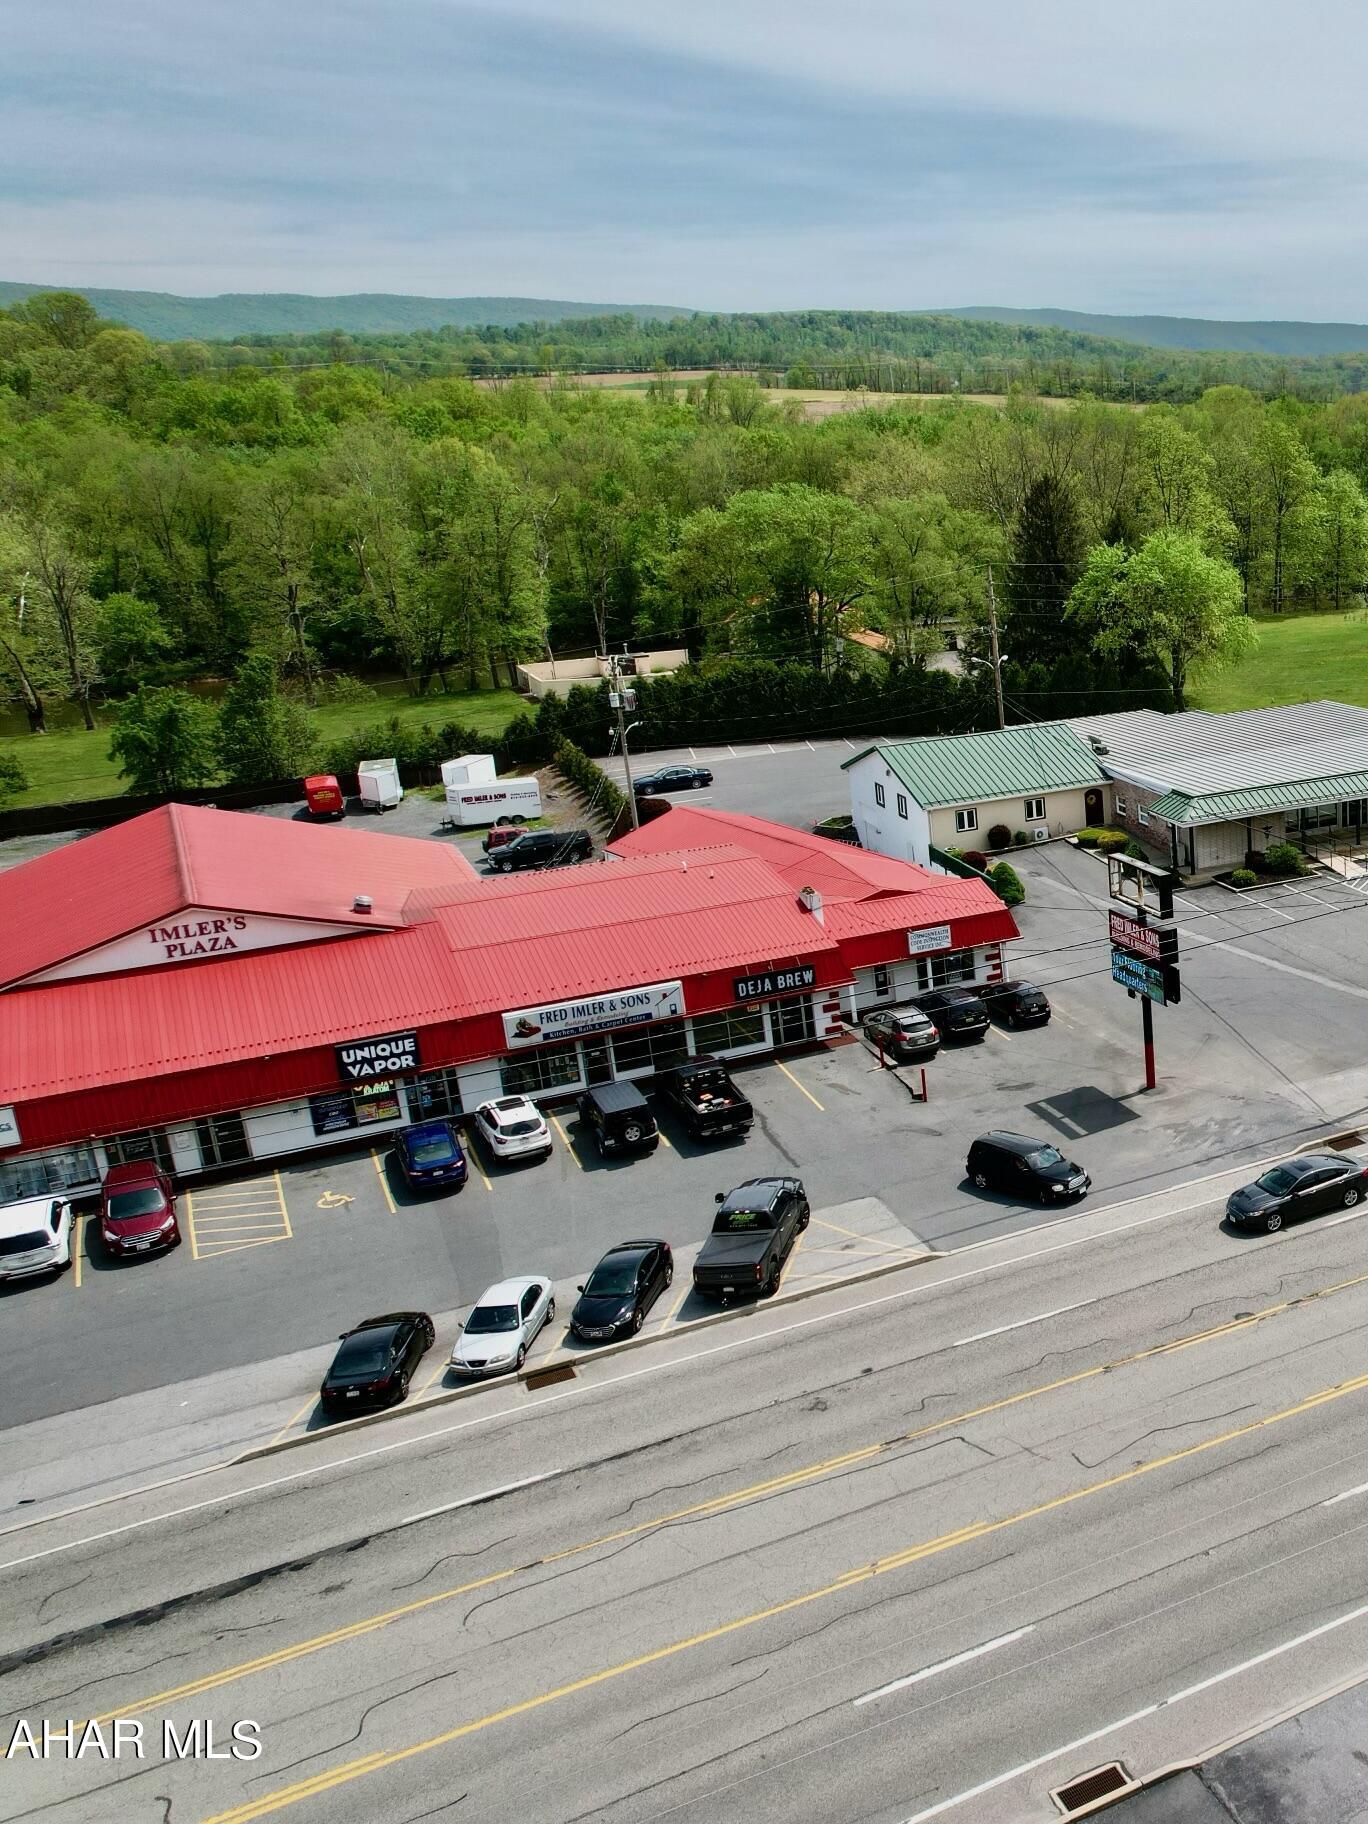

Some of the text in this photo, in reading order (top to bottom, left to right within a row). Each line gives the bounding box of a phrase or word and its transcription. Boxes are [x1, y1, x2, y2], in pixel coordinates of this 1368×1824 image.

[148, 916, 247, 943] IMLER'S
[165, 935, 238, 958] PLAZA
[738, 969, 813, 997] DEJA BREW
[539, 992, 651, 1025] FRED IMLER & SONS
[549, 1029, 577, 1038] Kitchen,
[601, 1019, 623, 1028] Carpet
[624, 1015, 646, 1023] Center
[341, 1038, 416, 1063] UNIQUE
[347, 1054, 416, 1077] VAPOR
